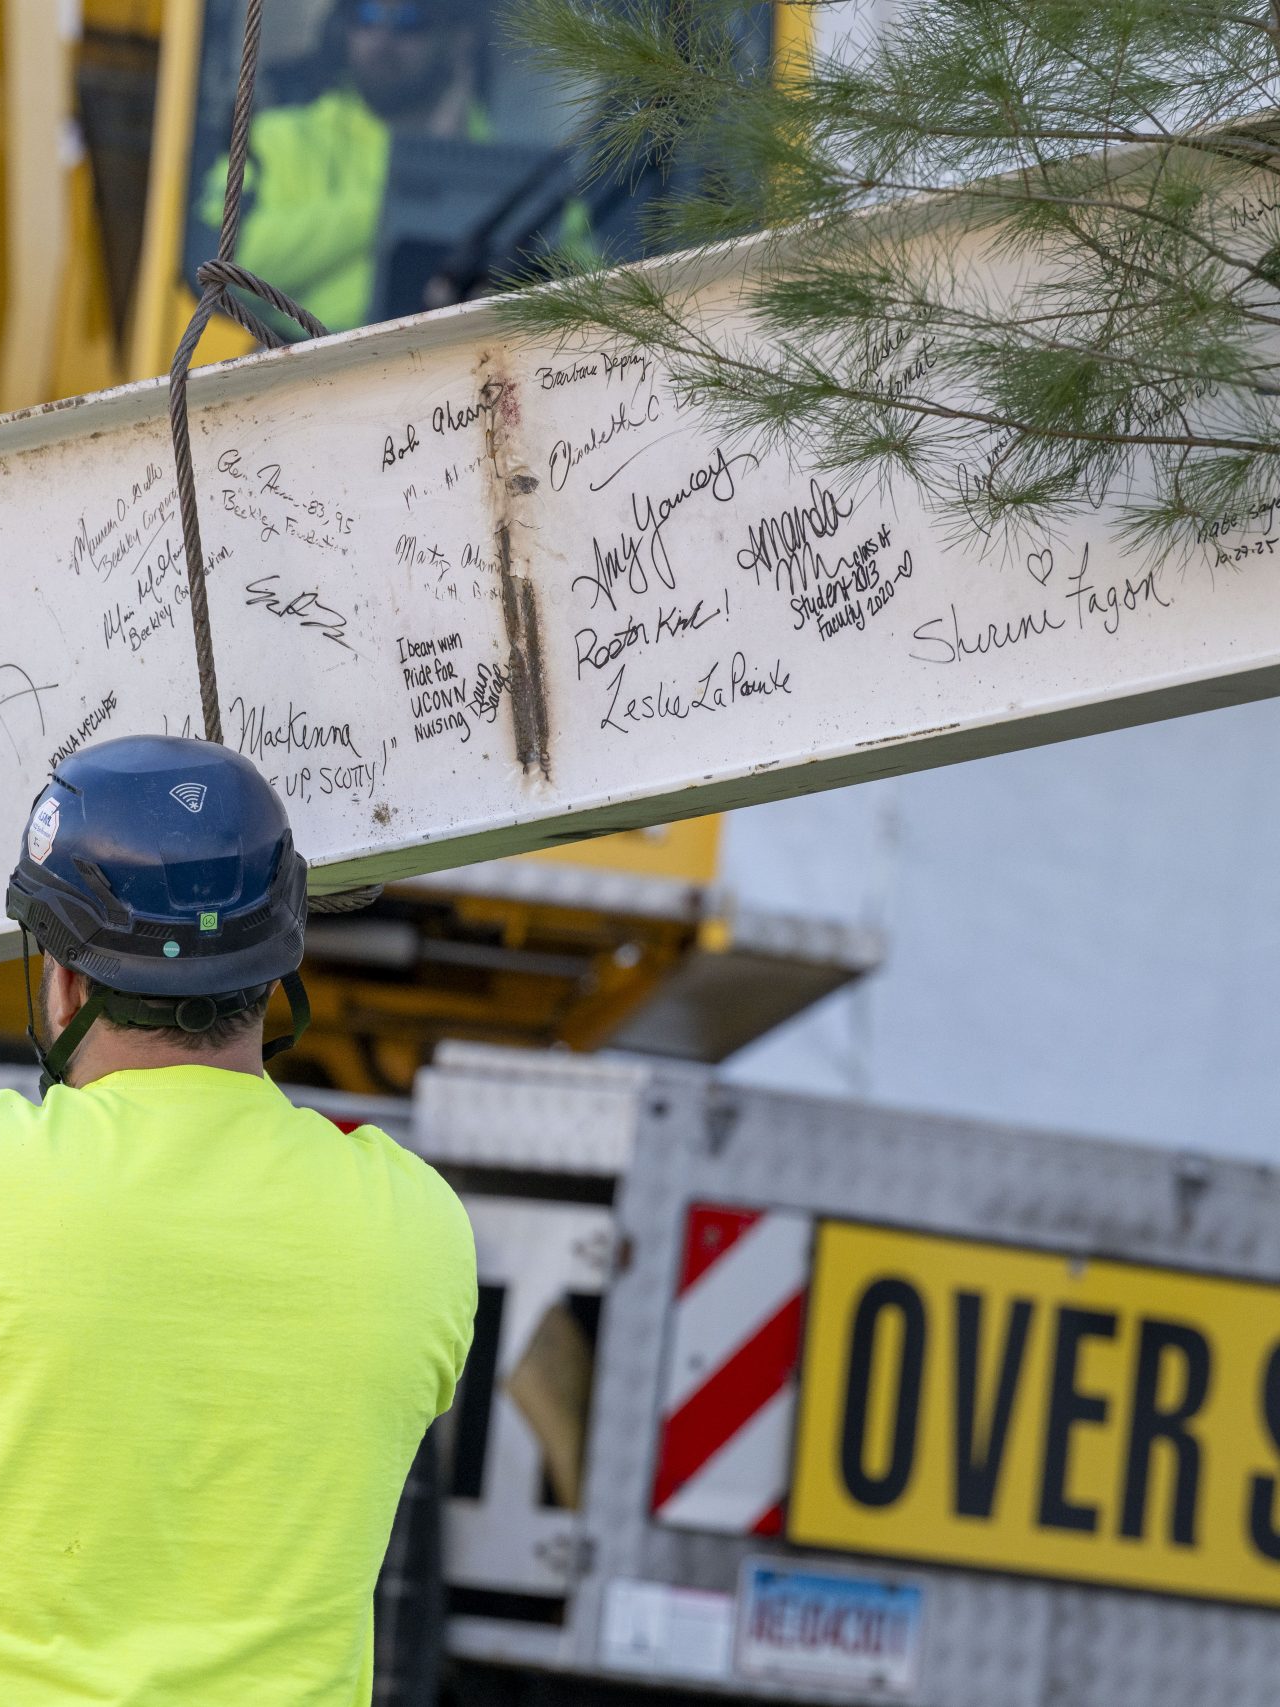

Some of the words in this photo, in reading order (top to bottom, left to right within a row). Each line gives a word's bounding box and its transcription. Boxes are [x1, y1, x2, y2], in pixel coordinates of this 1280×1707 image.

[736, 478, 853, 586] Amanda
[572, 535, 644, 612] Amy
[410, 677, 466, 719] UCONN
[600, 663, 690, 734] Leslie
[414, 711, 471, 743] Nursing
[47, 734, 81, 778] ENNA
